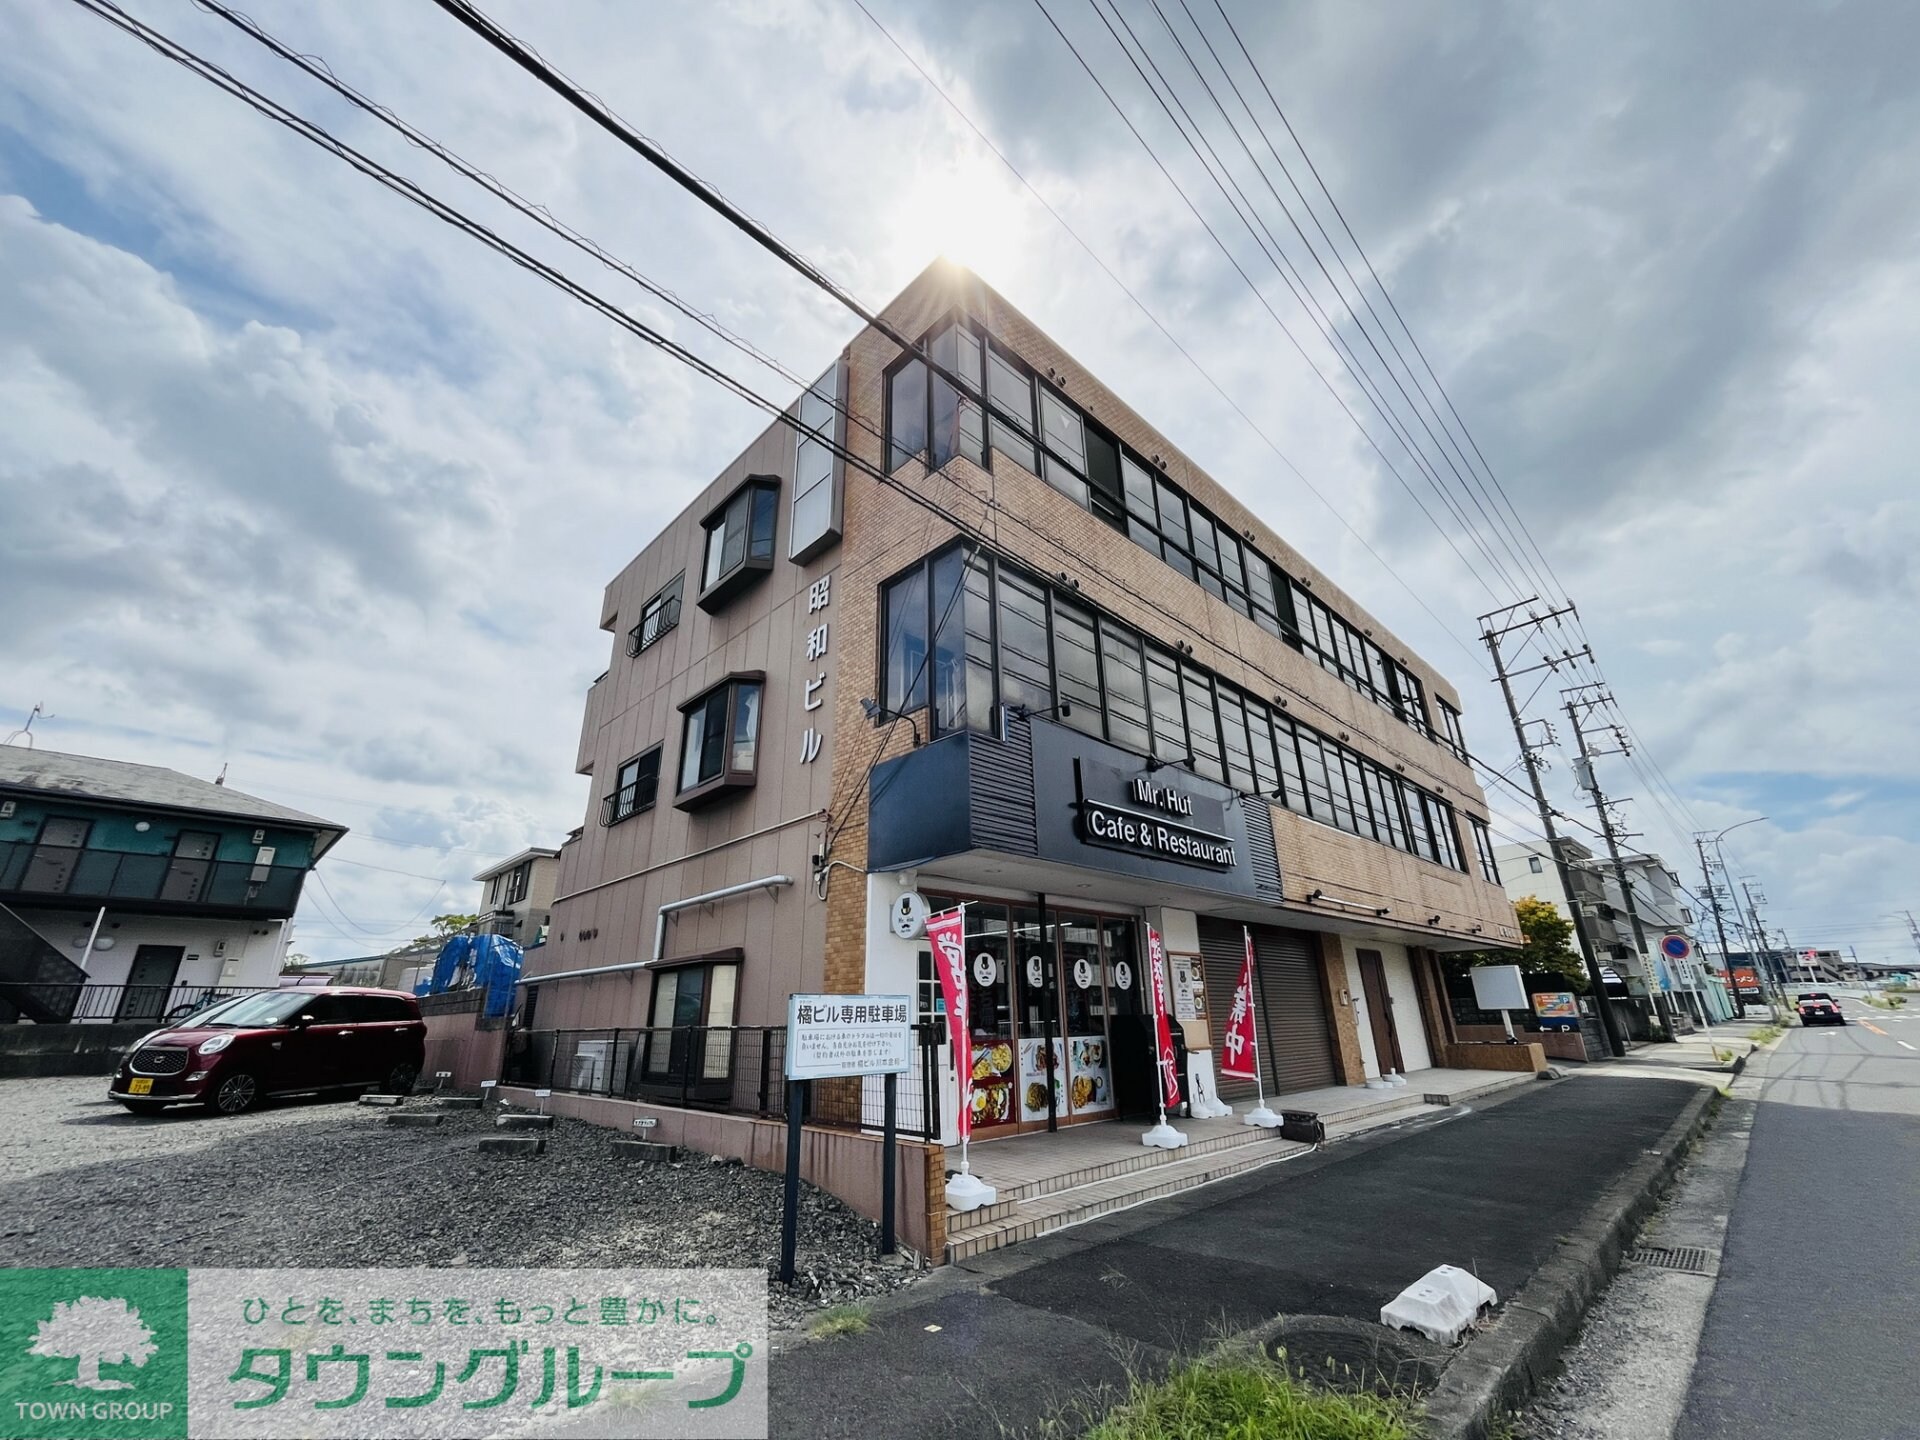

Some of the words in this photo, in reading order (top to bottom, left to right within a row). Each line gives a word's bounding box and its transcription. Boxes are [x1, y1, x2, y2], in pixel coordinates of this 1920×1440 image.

[800, 574, 831, 764] 昭和ビル
[1136, 778, 1164, 807] Mr.
[1166, 787, 1193, 816] Hut
[1090, 810, 1136, 841] Cafe
[1140, 822, 1153, 846] &
[1157, 827, 1238, 867] Restaurant
[796, 1004, 907, 1025] 橘ビル専用駐車場
